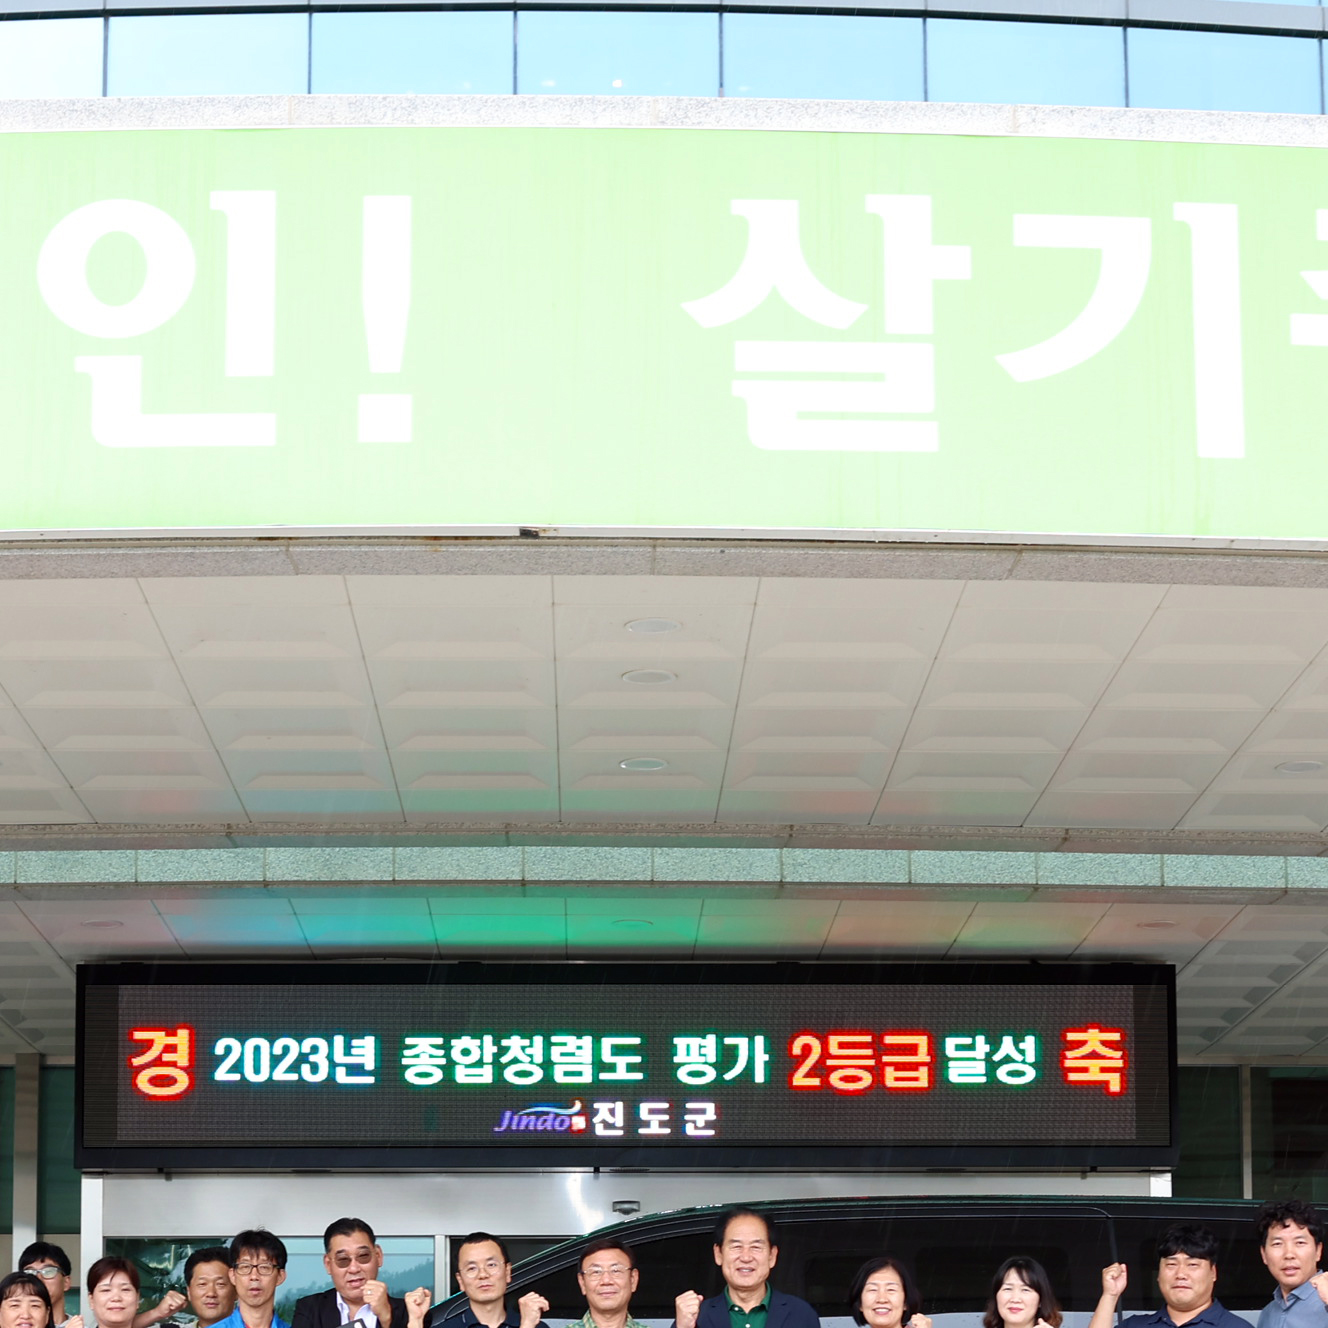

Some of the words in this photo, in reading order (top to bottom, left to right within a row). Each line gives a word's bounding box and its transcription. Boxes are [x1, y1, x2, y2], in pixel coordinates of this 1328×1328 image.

[131, 1029, 191, 1096] 경
[213, 1035, 376, 1084] 2023년
[401, 1035, 644, 1085] 종합청렴도
[673, 1034, 769, 1084] 평가
[790, 1034, 931, 1090] 2등급
[944, 1034, 1036, 1084] 달성
[1064, 1029, 1125, 1092] 축
[494, 1108, 571, 1132] Jindo
[592, 1100, 716, 1136] 진도군
